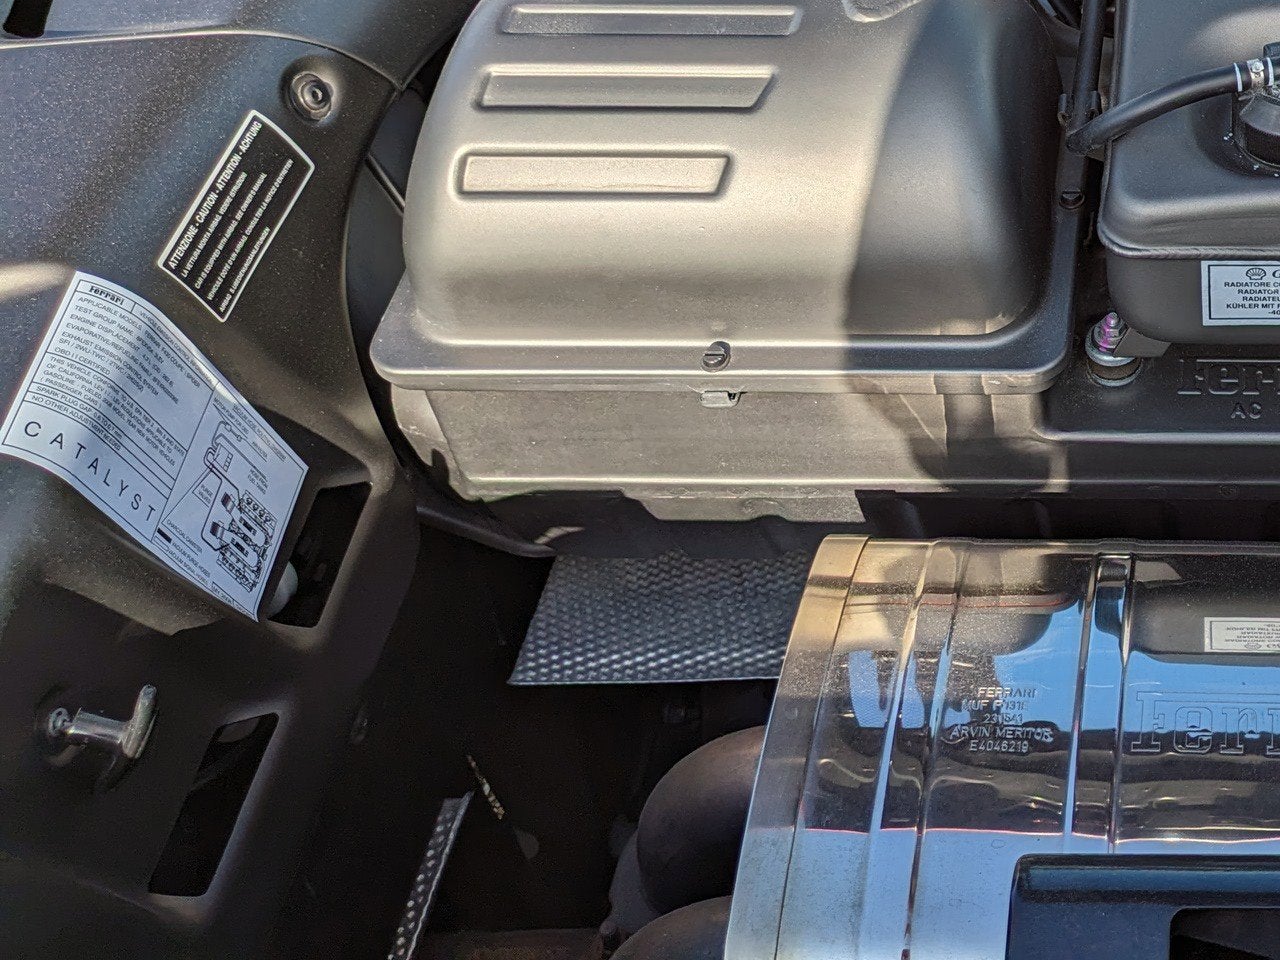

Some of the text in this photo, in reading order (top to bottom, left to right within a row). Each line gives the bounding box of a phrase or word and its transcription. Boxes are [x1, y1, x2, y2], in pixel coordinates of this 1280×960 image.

[167, 119, 262, 269] ATTENZIONE CAUTION ATTENTION ACHTUNG
[196, 230, 211, 249] MONTA
[184, 247, 201, 270] VETTURA
[194, 276, 204, 289] CAR
[203, 248, 221, 273] EQUIPPED
[180, 268, 189, 277] LA
[88, 284, 125, 305] Ferrari
[74, 304, 92, 315] TEST
[92, 310, 117, 326] GROUP
[77, 296, 118, 316] APPLICABLE
[70, 313, 97, 327] ENGINE
[97, 322, 140, 351] DISPLACEMENT
[61, 329, 94, 348] EXHAUST
[93, 342, 124, 364] EMISSION
[45, 361, 56, 370] OF
[57, 365, 94, 386] CALIFORNIA
[49, 355, 65, 366] THIS
[65, 361, 92, 377] VEHICLE
[78, 354, 111, 376] CERTIFIED
[42, 367, 76, 386] GASOLINE
[44, 376, 83, 397] PASSENGER
[35, 384, 60, 399] SPARK
[59, 393, 79, 407] PLUG
[31, 393, 44, 403] NO
[43, 398, 69, 413] OTHER
[68, 408, 105, 436] ADJUSTMENT
[1230, 403, 1262, 419] AC
[23, 420, 154, 520] CATALYST
[978, 687, 1036, 698] FERRARI
[950, 726, 990, 740] ARVIN
